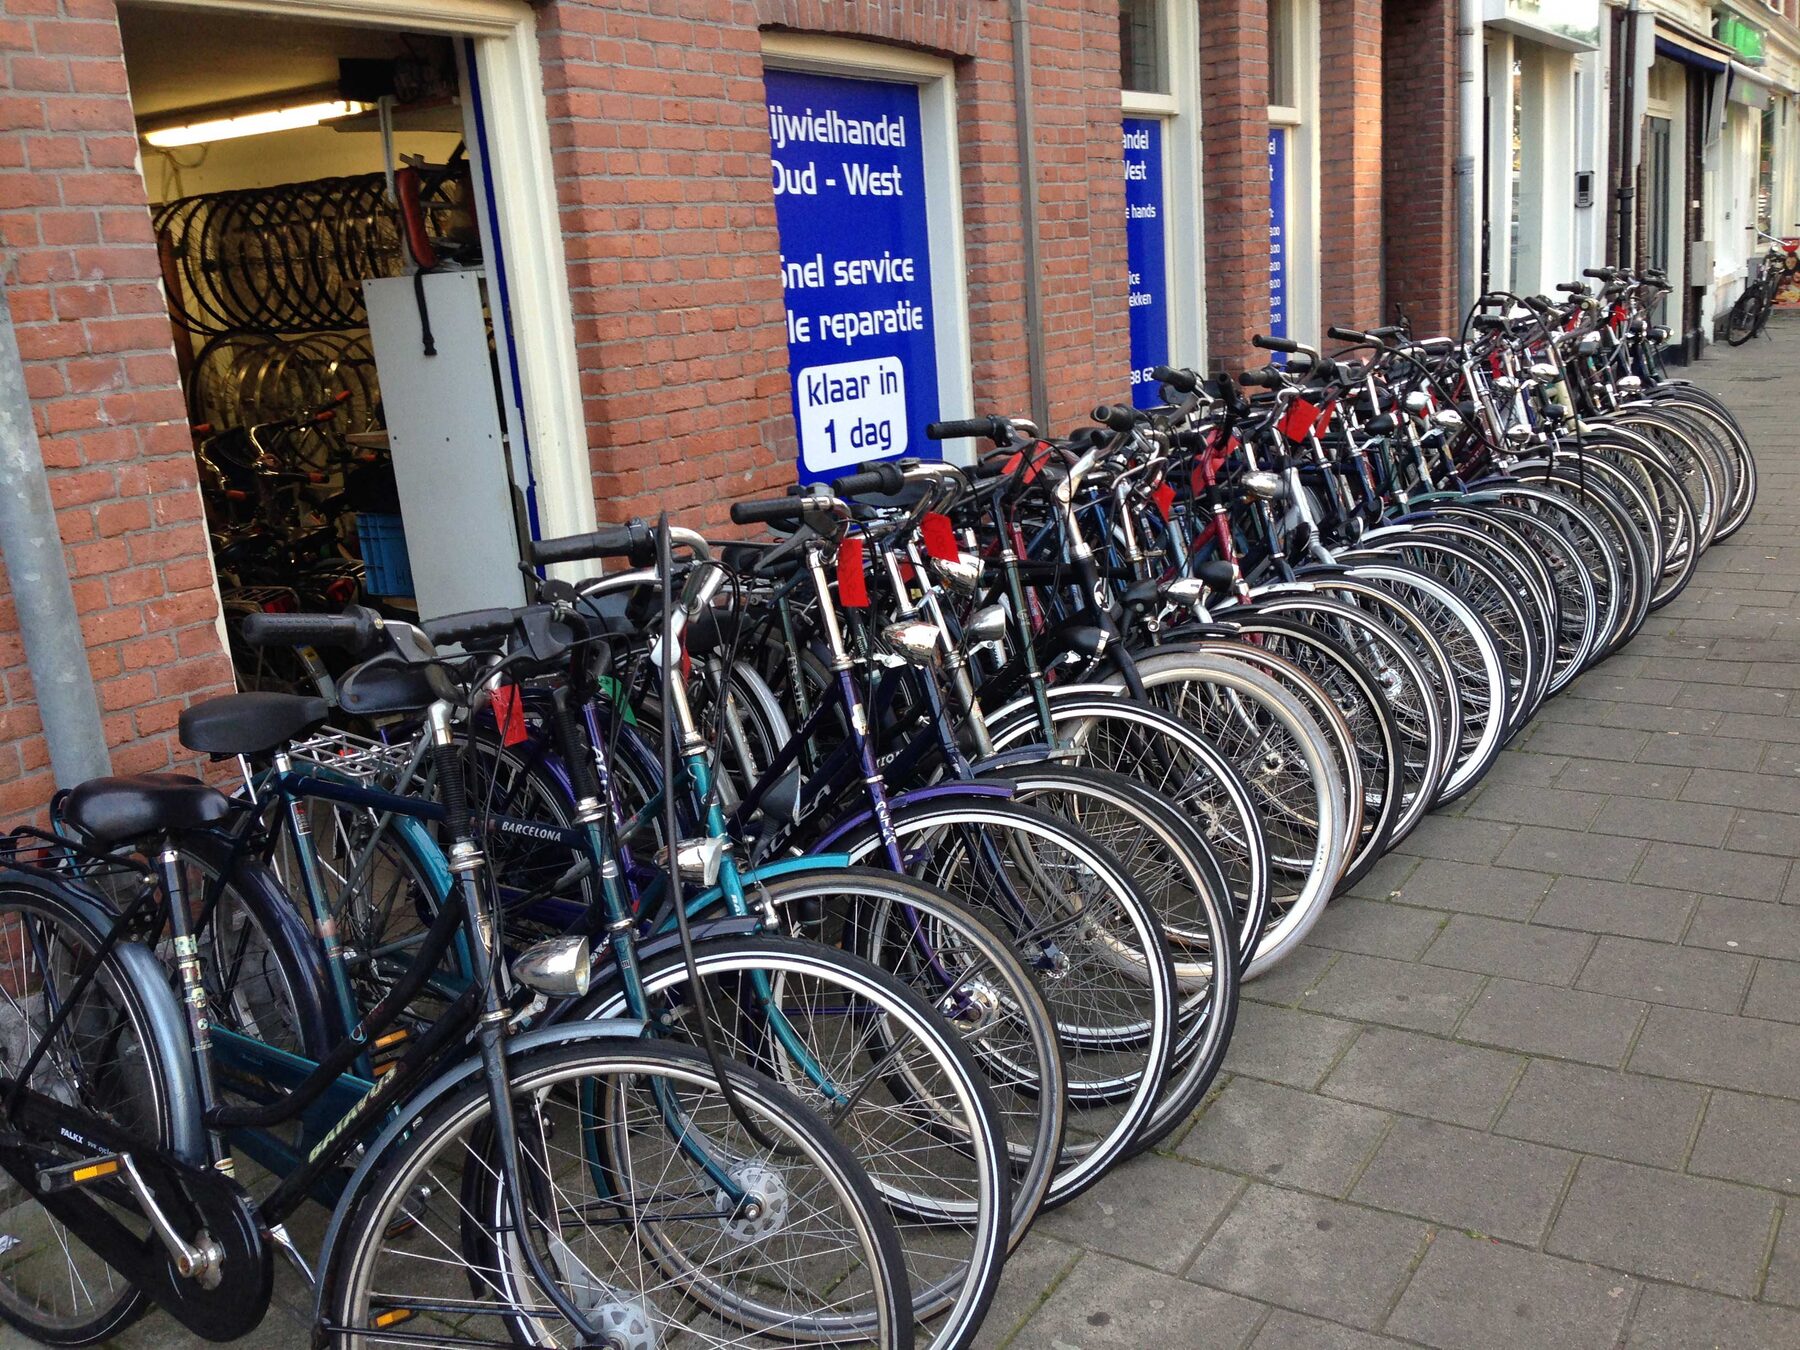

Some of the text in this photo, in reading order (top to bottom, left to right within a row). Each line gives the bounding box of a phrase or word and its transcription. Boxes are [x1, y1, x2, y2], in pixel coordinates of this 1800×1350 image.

[769, 104, 906, 149] ijwielhandel
[771, 159, 817, 196] Oud
[842, 161, 904, 197] West
[1131, 203, 1157, 219] hands
[833, 250, 915, 287] service
[784, 300, 924, 346] le reparatie
[806, 364, 899, 407] klaar in
[824, 416, 892, 454] 1 dag
[501, 820, 562, 842] BARCELONA
